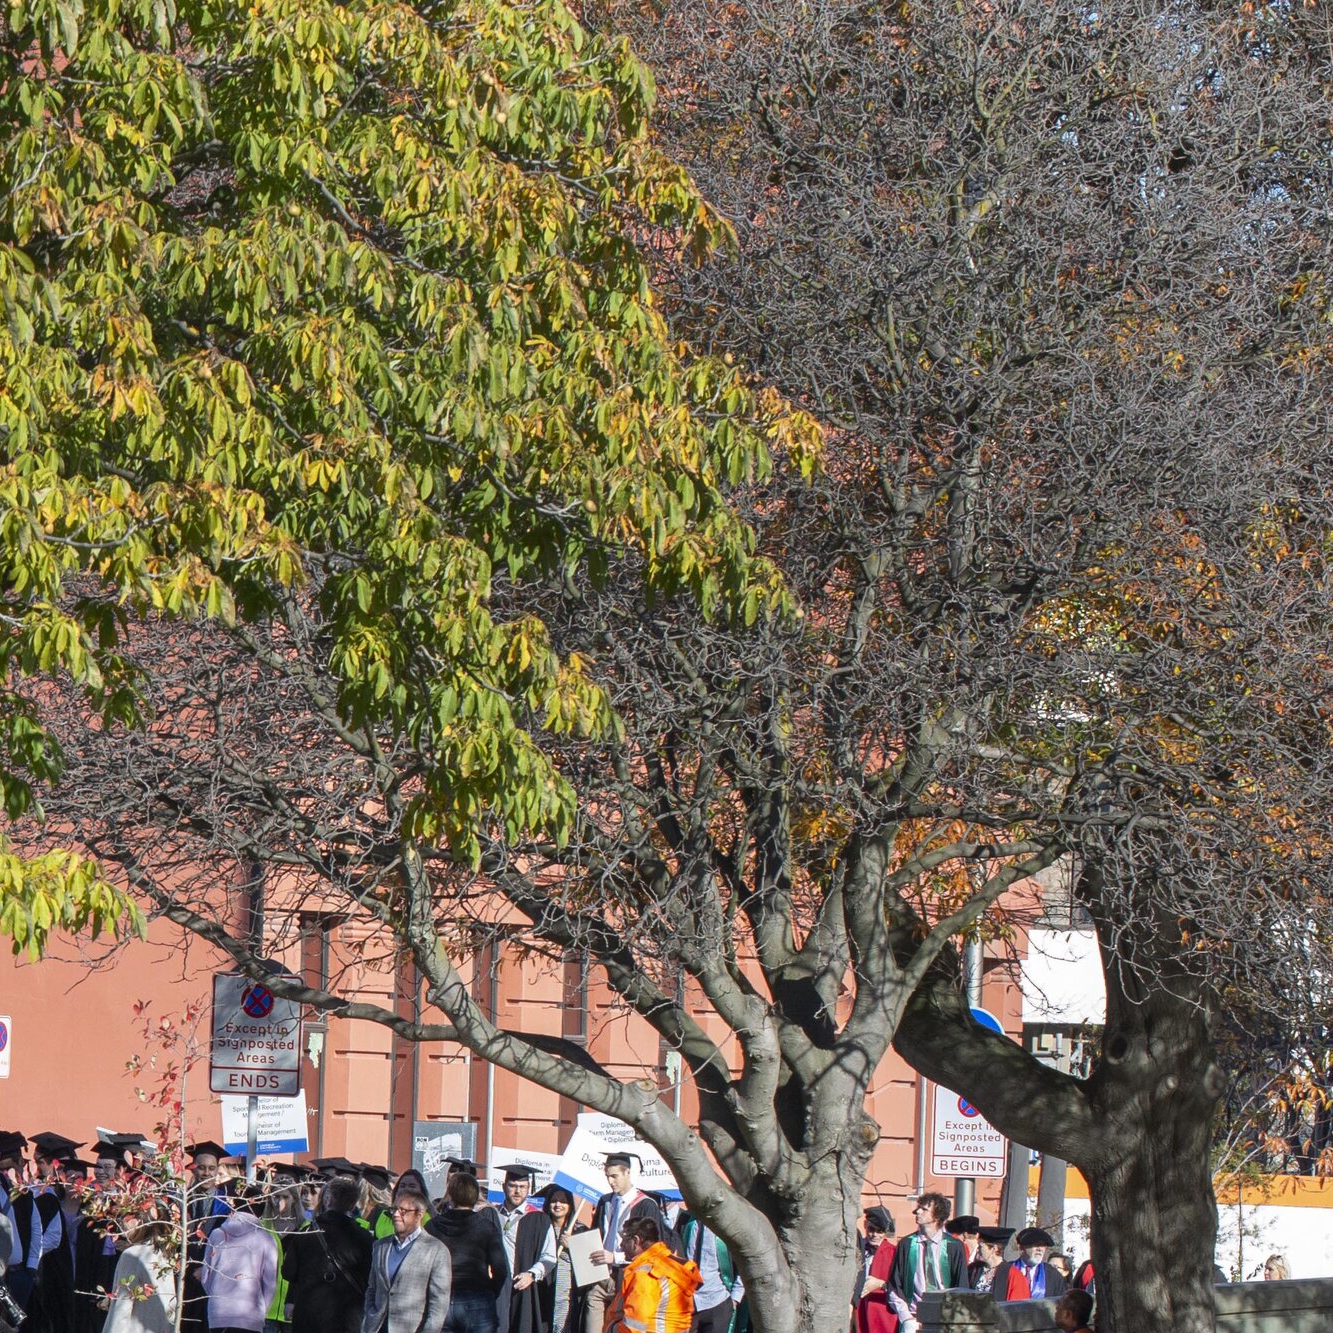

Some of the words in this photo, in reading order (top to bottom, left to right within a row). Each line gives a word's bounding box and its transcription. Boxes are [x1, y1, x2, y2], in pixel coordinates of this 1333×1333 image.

[226, 1022, 272, 1037] Except
[277, 1025, 288, 1035] in
[218, 1036, 295, 1050] Signposted
[236, 1052, 275, 1064] Areas
[229, 1073, 280, 1089] ENDS
[262, 1103, 294, 1111] Recreation
[258, 1128, 296, 1136] Management
[945, 1121, 982, 1132] Except
[939, 1131, 1001, 1143] Signposted
[954, 1143, 985, 1152] Areas
[515, 1157, 542, 1167] Diploma
[940, 1160, 997, 1172] BEGINS
